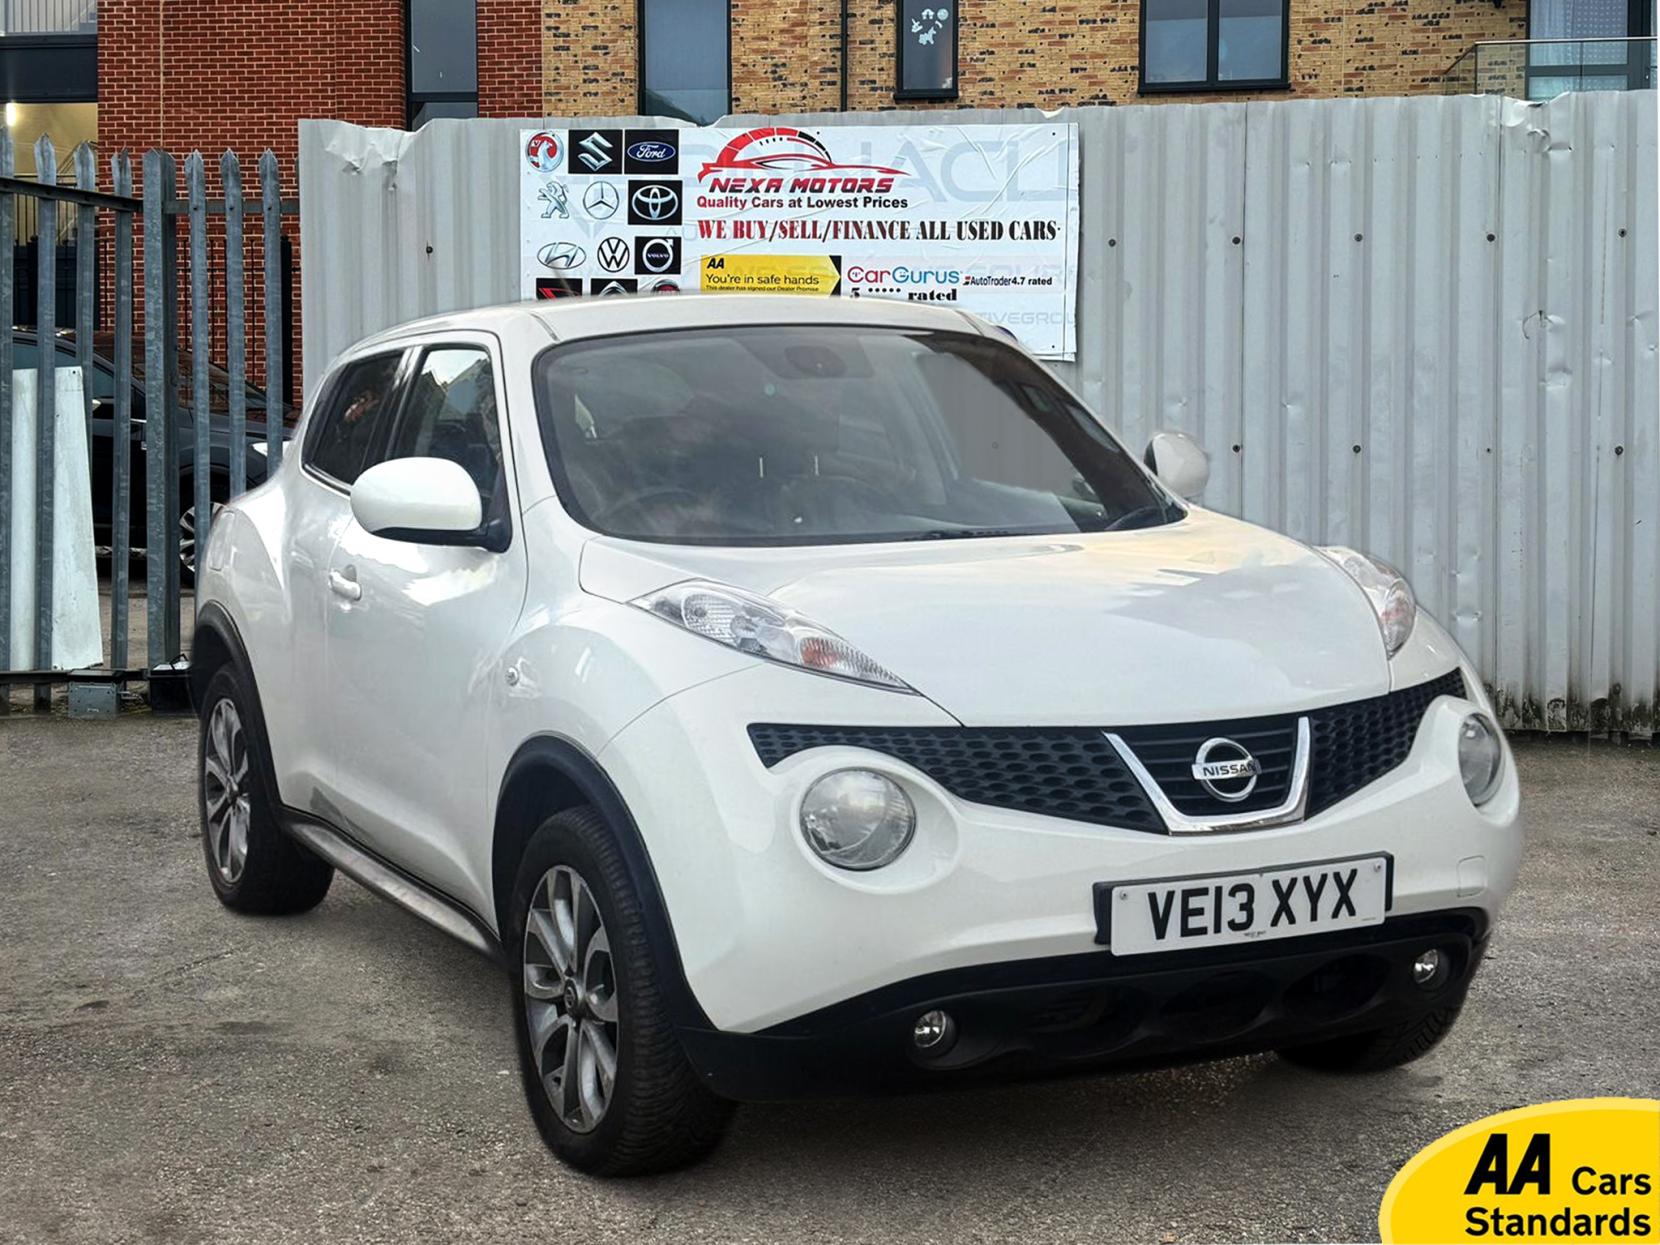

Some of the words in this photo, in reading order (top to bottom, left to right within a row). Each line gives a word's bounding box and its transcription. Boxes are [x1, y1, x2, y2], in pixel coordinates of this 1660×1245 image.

[636, 144, 666, 158] Ford
[709, 178, 784, 193] NEXA
[789, 178, 894, 193] MOTORS
[697, 196, 747, 210] Quality
[752, 196, 784, 208] Cars
[788, 197, 803, 208] at
[807, 196, 859, 208] Lowest
[863, 196, 908, 208] Prices
[698, 219, 727, 239] WE
[916, 220, 950, 240] ALL
[957, 220, 1004, 240] USED
[1009, 220, 1057, 240] CARS
[707, 257, 725, 269] AA
[706, 274, 741, 284] You're
[744, 274, 754, 284] in
[757, 274, 781, 284] safe
[784, 274, 820, 285] hands
[847, 266, 960, 284] CarGurus
[1028, 277, 1053, 286] rated
[908, 288, 957, 301] rated
[1203, 761, 1256, 776] NISSAN
[1148, 883, 1255, 940] VE13
[1270, 868, 1358, 928] XYX
